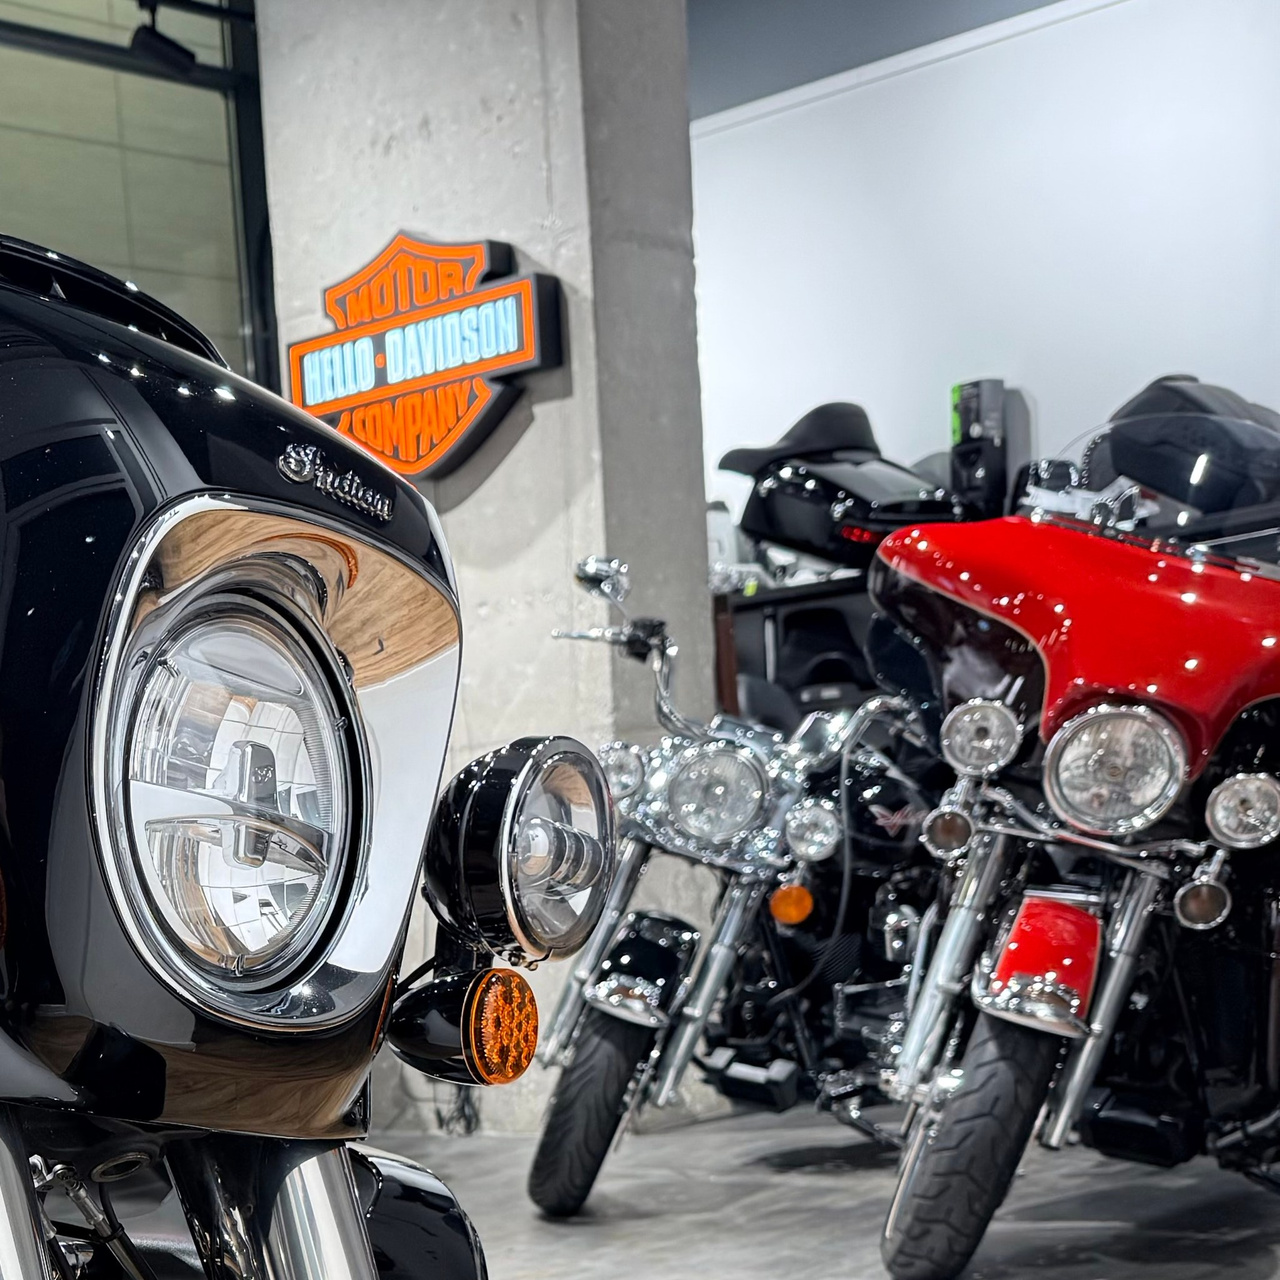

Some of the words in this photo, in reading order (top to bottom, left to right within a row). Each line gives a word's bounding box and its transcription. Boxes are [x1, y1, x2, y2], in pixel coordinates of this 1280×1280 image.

[346, 254, 465, 326] MOTOR
[302, 337, 375, 406] HELLO
[385, 296, 519, 384] DAVIDSON
[352, 378, 473, 462] COMPANY
[277, 443, 394, 521] Indian
